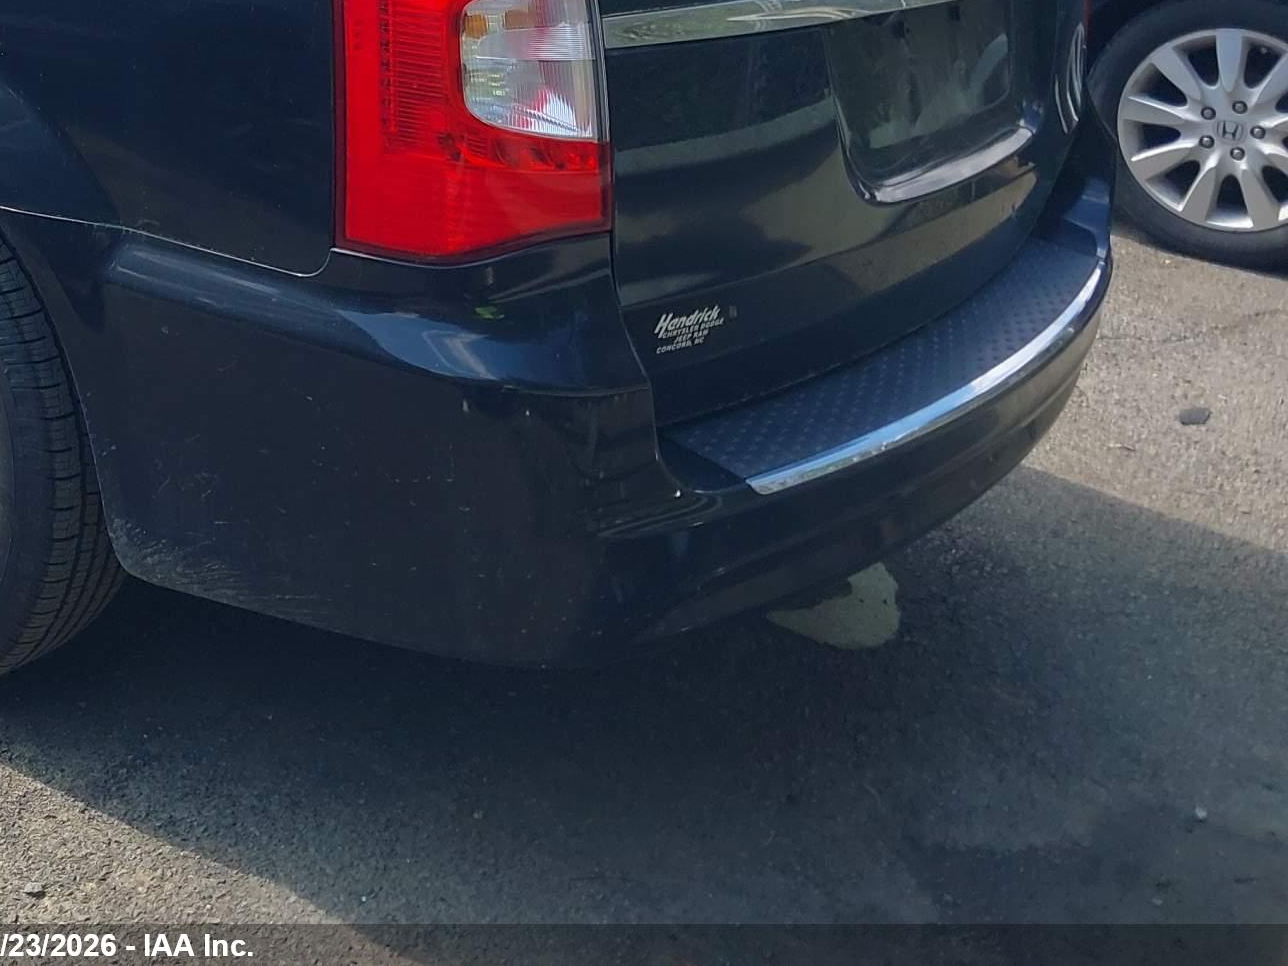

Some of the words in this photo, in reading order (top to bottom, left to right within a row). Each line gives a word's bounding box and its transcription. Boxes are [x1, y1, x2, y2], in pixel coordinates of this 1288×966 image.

[653, 305, 721, 338] Hendrick
[662, 325, 699, 338] CHRYSLER
[700, 317, 724, 330] DODGE
[673, 333, 692, 344] JEEP
[693, 329, 709, 338] RAM
[694, 336, 705, 345] NC
